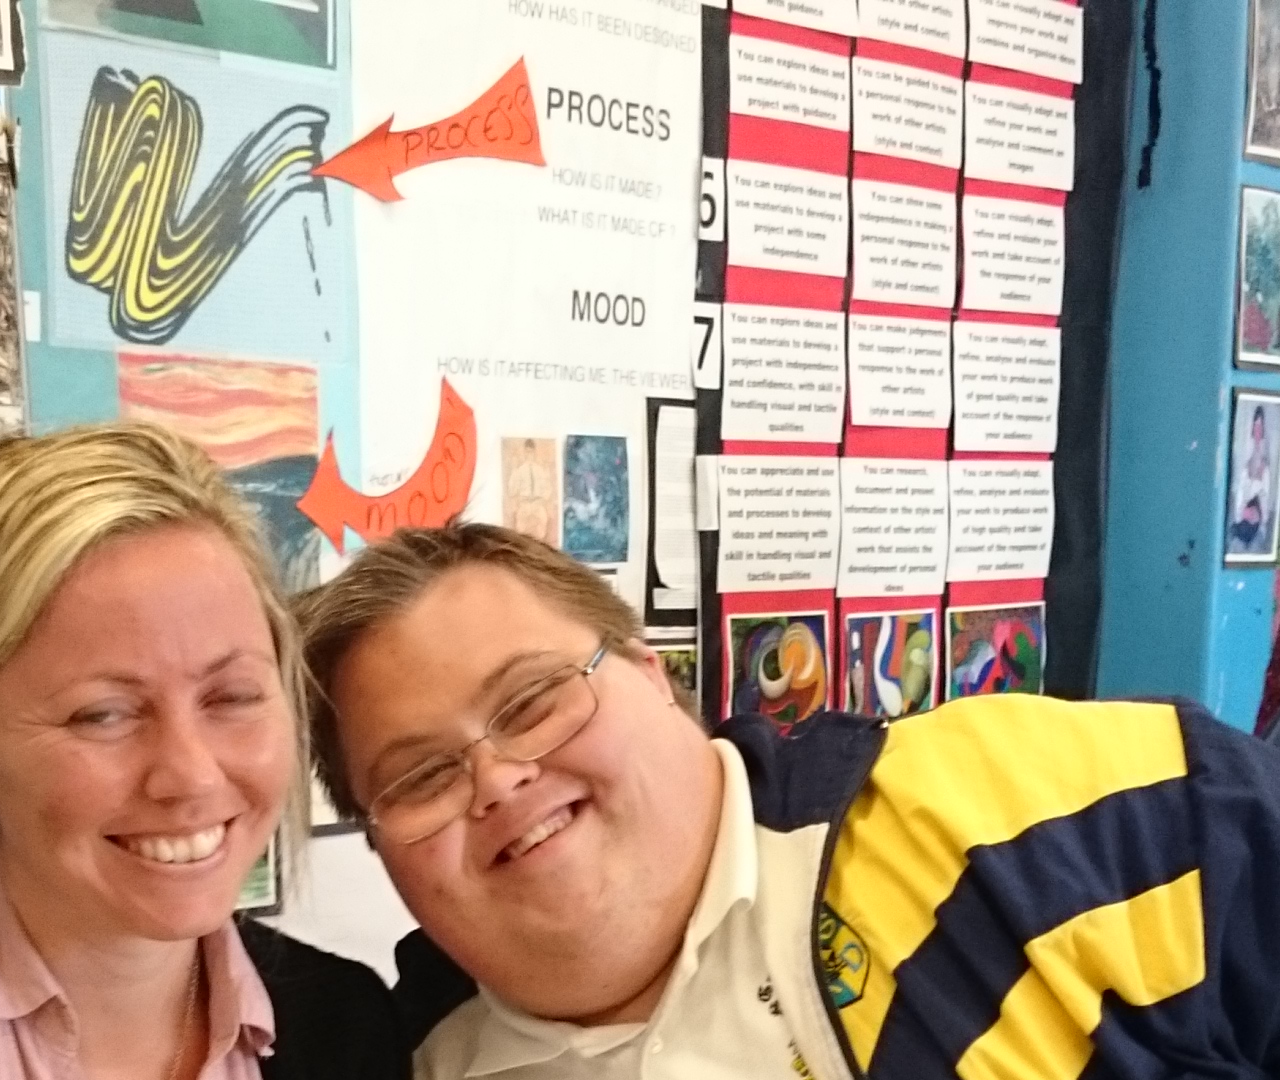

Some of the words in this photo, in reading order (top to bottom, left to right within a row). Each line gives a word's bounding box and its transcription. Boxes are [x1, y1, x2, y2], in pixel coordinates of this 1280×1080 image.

[549, 4, 578, 25] HAS
[582, 11, 592, 27] IT
[597, 14, 632, 37] BEEN
[635, 24, 697, 53] DESIGNED
[402, 84, 533, 165] PROCESS
[546, 87, 671, 141] PROCESS
[552, 168, 587, 187] HOW
[590, 173, 602, 190] IS
[605, 175, 615, 191] IT
[618, 178, 653, 198] MADE
[537, 206, 578, 224] WHAT
[581, 212, 594, 229] IS
[597, 214, 607, 230] IT
[611, 216, 645, 236] MADE
[572, 290, 646, 327] MOOD
[693, 316, 715, 370] 7
[437, 357, 474, 374] HOW
[478, 359, 491, 376] IS
[494, 360, 505, 377] IT
[508, 361, 585, 382] AFFECTING
[613, 368, 637, 386] THE
[721, 465, 737, 476] You
[740, 467, 757, 476] can
[760, 465, 804, 479] appreciate
[806, 466, 819, 477] and
[821, 468, 834, 477] use
[726, 486, 741, 497] the
[743, 486, 783, 499] potential
[794, 486, 830, 497] materials
[727, 507, 743, 518] and
[745, 509, 789, 520] processes
[801, 507, 831, 520] develop
[731, 528, 754, 539] ideas
[757, 528, 773, 539] and
[775, 528, 809, 542] meaning
[811, 528, 828, 539] with
[724, 549, 743, 561] skill
[755, 549, 791, 563] handling
[793, 548, 816, 560] visual
[817, 548, 831, 559] and
[746, 569, 776, 581] tactile
[778, 568, 811, 583] qualities
